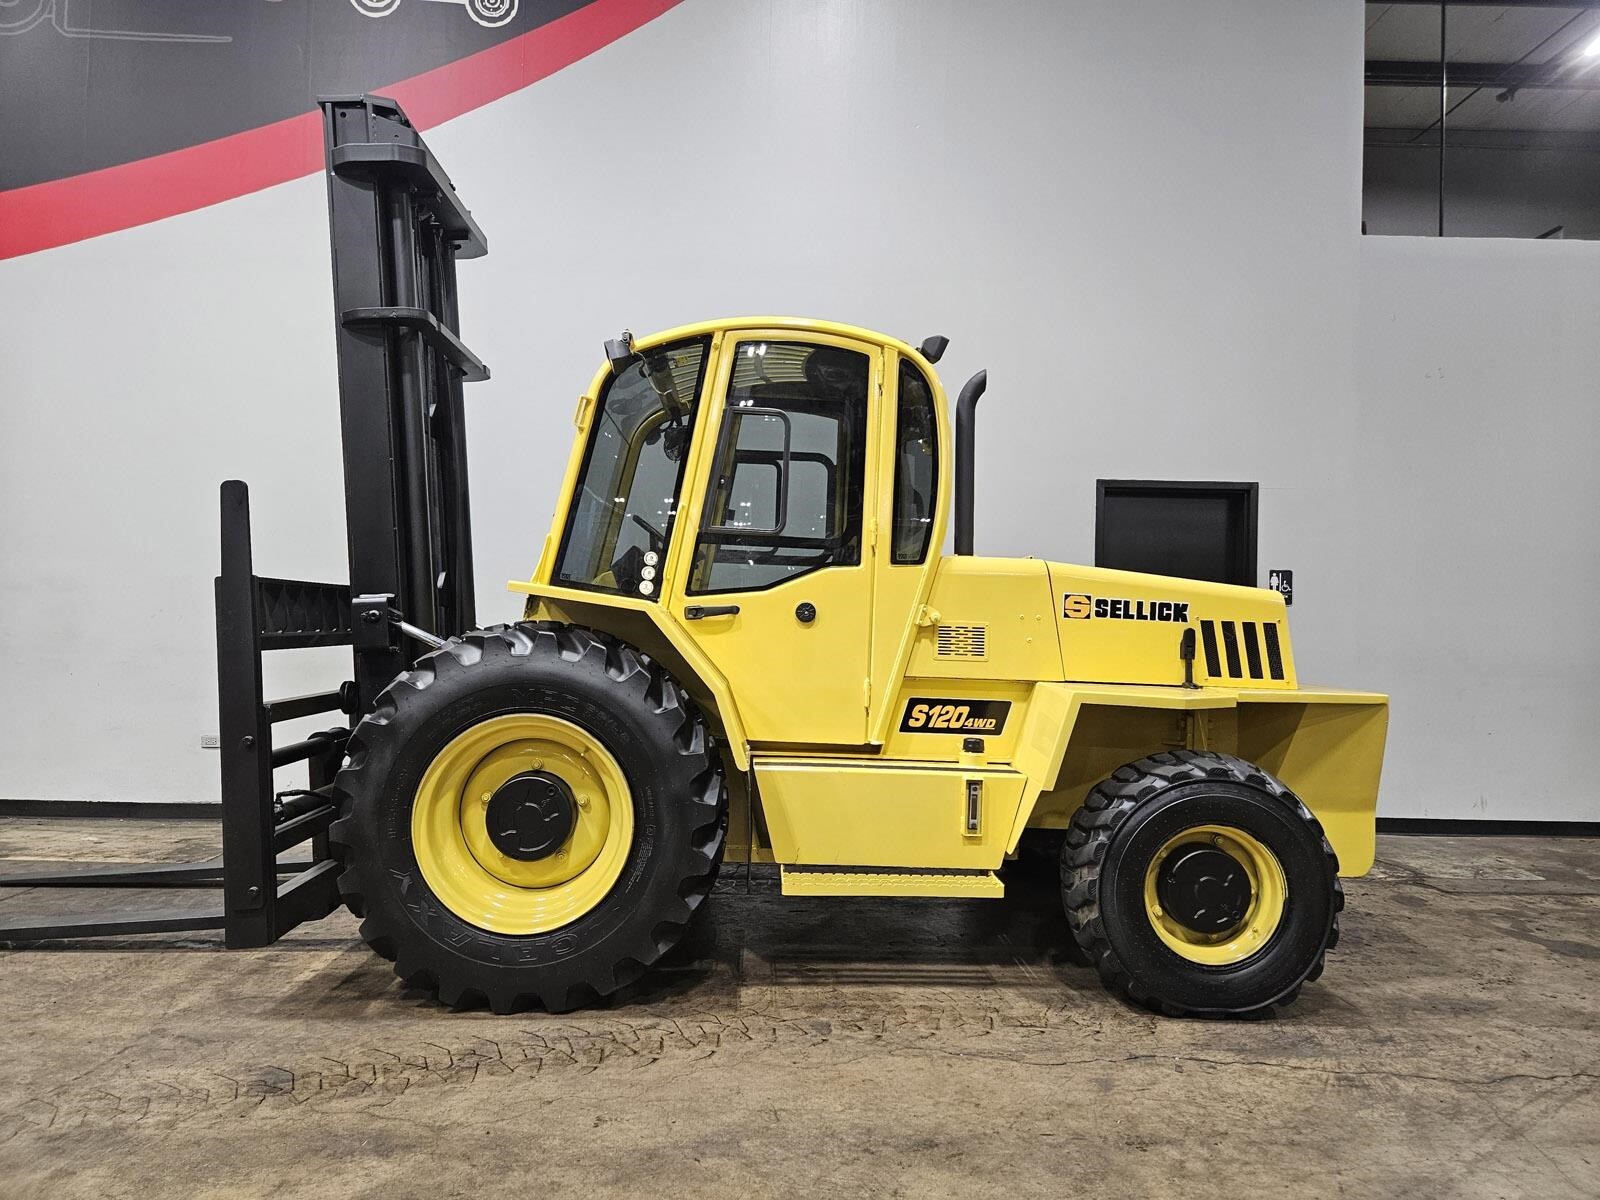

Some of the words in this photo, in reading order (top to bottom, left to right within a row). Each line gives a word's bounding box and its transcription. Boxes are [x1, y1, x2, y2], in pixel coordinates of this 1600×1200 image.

[1094, 599, 1189, 623] SELLICK
[908, 704, 970, 729] S120
[964, 718, 996, 728] 4WD
